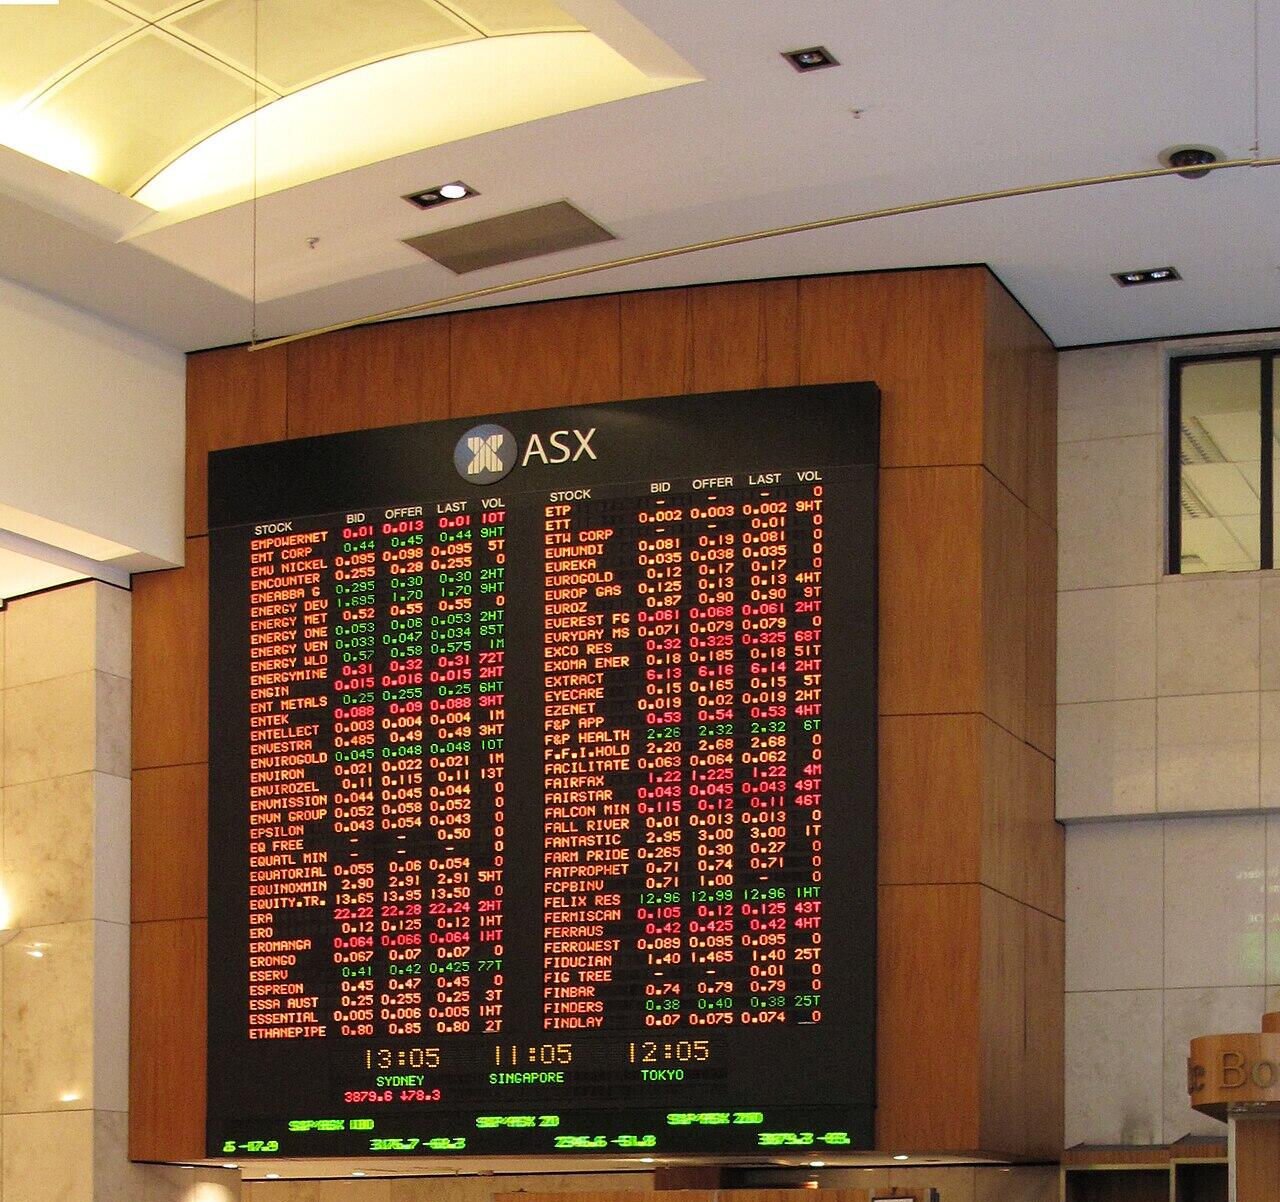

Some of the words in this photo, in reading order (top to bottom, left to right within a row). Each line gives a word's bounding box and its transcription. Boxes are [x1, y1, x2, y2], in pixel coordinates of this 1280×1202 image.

[522, 428, 597, 467] ASX
[550, 489, 591, 503] STOCK
[650, 482, 671, 494] BID
[692, 477, 733, 490] OFFER
[749, 473, 781, 486] LAST
[797, 471, 822, 482] VOL
[255, 522, 293, 535] STOCK
[347, 513, 365, 524] BID
[385, 506, 423, 520] OFFER
[437, 501, 467, 514] LAST
[481, 498, 506, 509] VOL
[545, 518, 571, 531] ETT
[638, 509, 682, 523] 0.002
[689, 505, 734, 519] 0.003
[742, 501, 787, 515] 0.002
[795, 499, 822, 511] 9HT
[250, 531, 328, 550] EMPOWERNET
[342, 525, 372, 538] 0.01
[382, 519, 423, 534] 0.013
[438, 515, 470, 528] 0.01
[481, 511, 505, 523] 10T
[250, 551, 274, 563] EMT
[280, 546, 312, 559] CORP
[343, 540, 374, 552] 0.44
[391, 534, 422, 547] 0.45
[439, 529, 471, 541] 0.44
[480, 526, 504, 537] 9HT
[250, 572, 320, 590] ENCOUNTER
[334, 565, 375, 580] 0.255
[390, 560, 423, 574] 0.28
[430, 556, 472, 570] 0.255
[544, 587, 587, 600] EUROP
[595, 584, 621, 597] GAS
[637, 580, 681, 594] 0.125
[698, 576, 733, 589] 0.13
[750, 573, 786, 586] 0.13
[795, 571, 821, 583] 4HT
[250, 616, 296, 631] ENERGY
[303, 612, 327, 624] MET
[342, 607, 374, 620] 0.52
[389, 602, 423, 615] 0.55
[438, 597, 471, 611] 0.55
[543, 658, 586, 671] EXOMA
[594, 655, 629, 668] ENER
[646, 652, 681, 665] 0.18
[689, 649, 733, 662] 0.185
[750, 646, 785, 658] 0.18
[794, 644, 821, 656] 51T
[250, 685, 289, 699] ENGIN
[334, 676, 374, 690] 0.015
[381, 672, 422, 686] 0.016
[429, 668, 471, 682] 0.015
[479, 665, 504, 678] 2HT
[544, 718, 570, 731] F&P
[577, 716, 604, 728] APP
[646, 711, 681, 724] 0.53
[697, 708, 733, 721] 0.54
[750, 705, 786, 718] 0.53
[794, 703, 821, 715] 4HT
[544, 775, 604, 789] FAIRFAX
[648, 770, 681, 783] 1.22
[691, 767, 733, 781] 1.225
[753, 765, 786, 777] 1.22
[803, 763, 821, 775] 4M
[249, 824, 304, 839] EPSILON
[333, 819, 374, 832] 0.043
[381, 816, 421, 829] 0.054
[429, 812, 470, 826] 0.043
[544, 833, 620, 848] FANTASTIC
[645, 830, 681, 843] 2.95
[697, 827, 733, 840] 3.00
[750, 825, 785, 838] 3.00
[805, 824, 821, 836] 1T
[249, 895, 325, 910] EQUITY.TR.
[335, 892, 374, 904] 13.65
[383, 889, 421, 901] 13.95
[431, 886, 470, 899] 13.50
[544, 895, 586, 908] FELIX
[594, 893, 620, 905] RES
[640, 892, 680, 903] 12.96
[692, 889, 732, 901] 12.99
[744, 887, 785, 899] 12.96
[797, 886, 820, 897] 1HT
[249, 939, 311, 953] EROMANGA
[333, 935, 373, 948] 0.064
[380, 933, 421, 946] 0.066
[429, 931, 469, 943] 0.064
[479, 929, 502, 941] 1HT
[249, 1025, 326, 1039] ETHANEPIPE
[341, 1023, 373, 1035] 0.80
[388, 1022, 421, 1034] 0.85
[436, 1020, 469, 1032] 0.80
[485, 1019, 502, 1032] 2T
[543, 1016, 603, 1028] FINDLAY
[645, 1013, 680, 1025] 0.07
[689, 1012, 733, 1024] 0.075
[741, 1011, 785, 1023] 0.074
[365, 1048, 440, 1069] 13:05
[495, 1044, 572, 1066] 11:05
[629, 1041, 709, 1063] 12:05
[376, 1075, 425, 1088] SYDNEY
[489, 1072, 565, 1084] SINGAPORE
[641, 1069, 684, 1082] TOKYO
[344, 1090, 393, 1103] 3879.6
